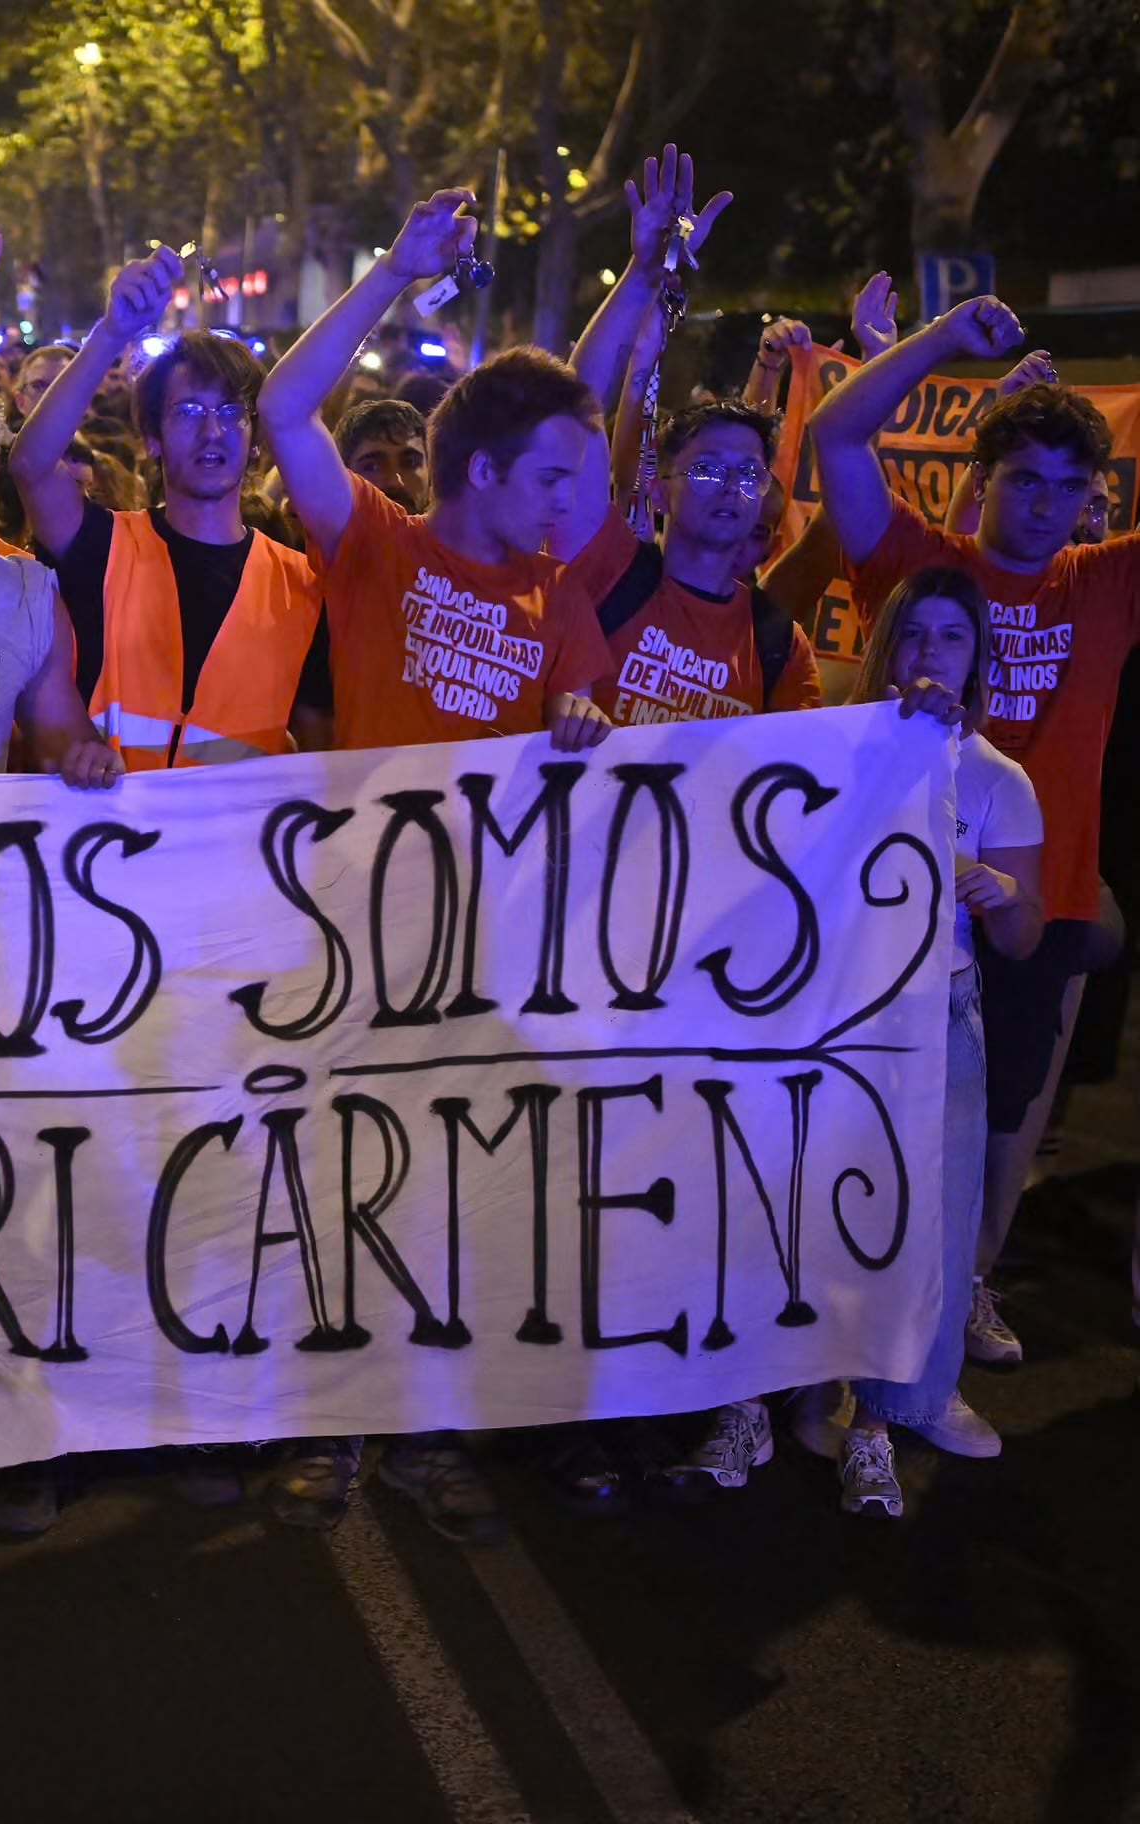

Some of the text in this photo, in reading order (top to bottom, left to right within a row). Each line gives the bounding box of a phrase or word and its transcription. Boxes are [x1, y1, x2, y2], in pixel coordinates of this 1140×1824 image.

[938, 257, 978, 318] P
[624, 658, 658, 691] DE
[229, 761, 840, 1040] SOMOS
